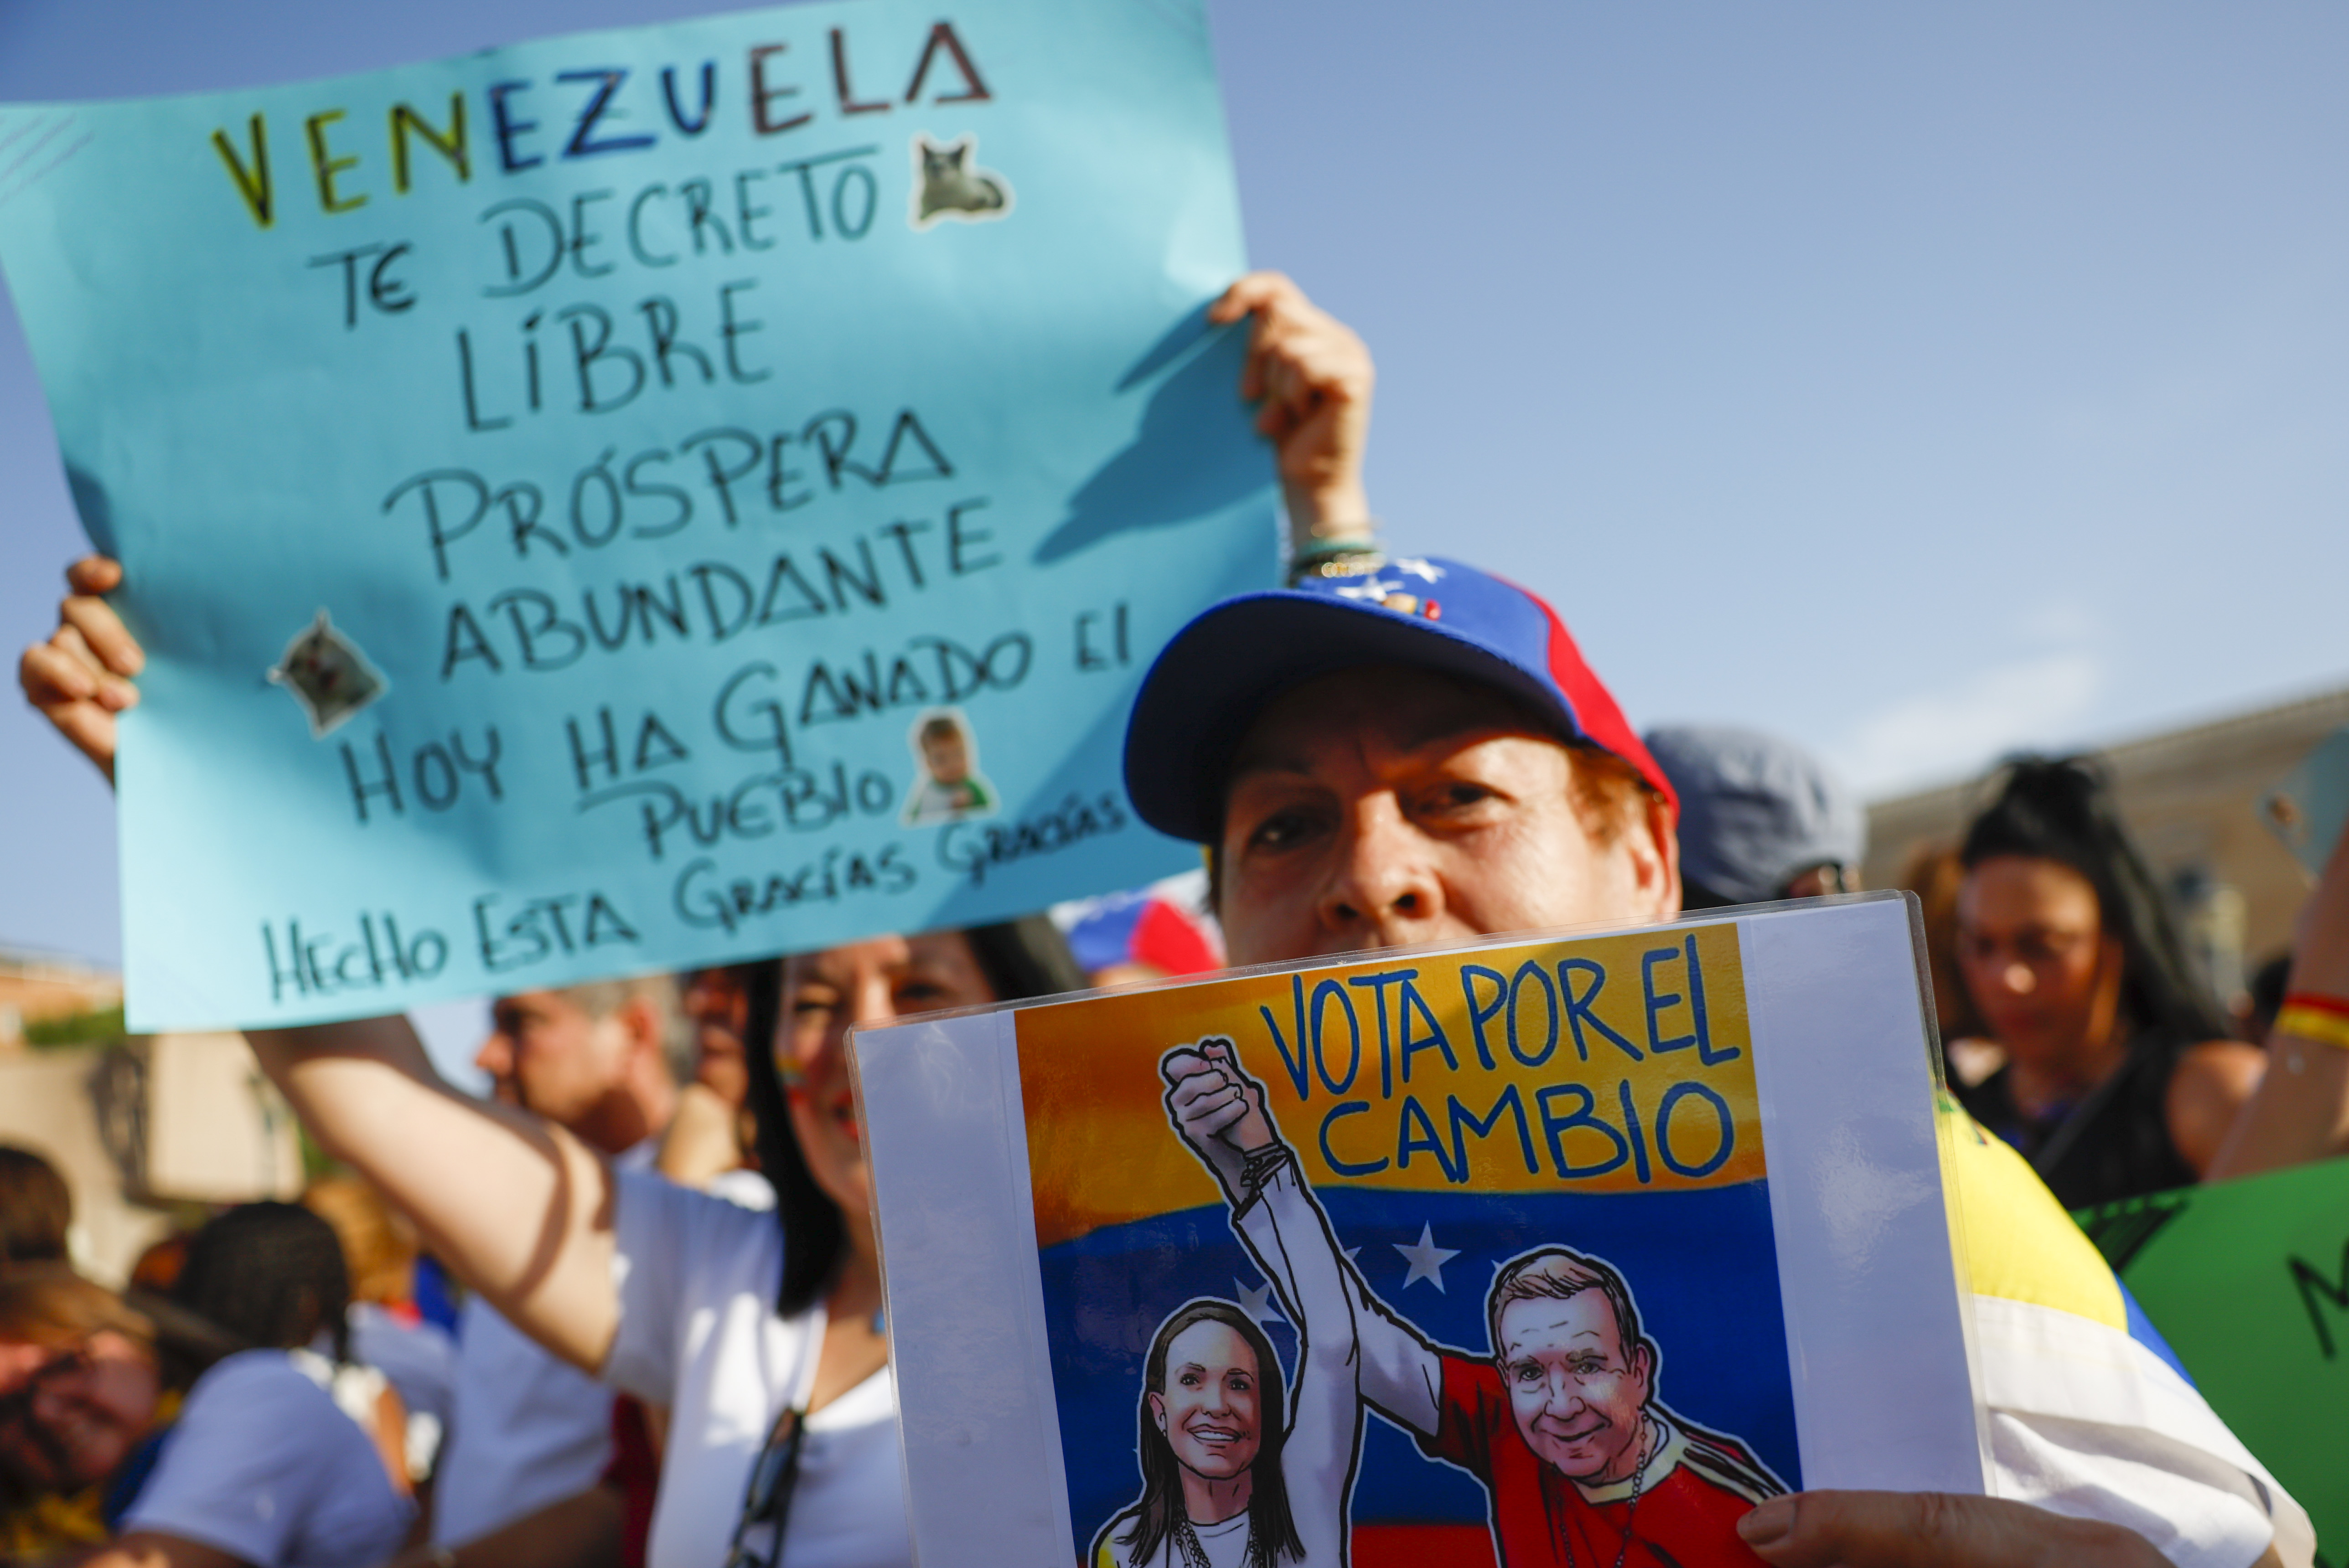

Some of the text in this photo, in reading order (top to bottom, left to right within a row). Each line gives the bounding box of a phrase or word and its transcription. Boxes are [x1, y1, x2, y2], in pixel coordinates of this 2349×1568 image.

[214, 20, 994, 229] VENEZUELA
[307, 144, 882, 331] TE DECRETO
[381, 407, 957, 584] PRÓSPERA
[440, 495, 1003, 682] ABUNDANTE
[339, 725, 503, 824] HOY
[566, 705, 689, 792] HA
[712, 631, 1034, 771] GANADO
[474, 890, 639, 975] ESTA
[1259, 933, 1741, 1100] VOTA POR EL
[1319, 1078, 1734, 1184] CAMBIO
